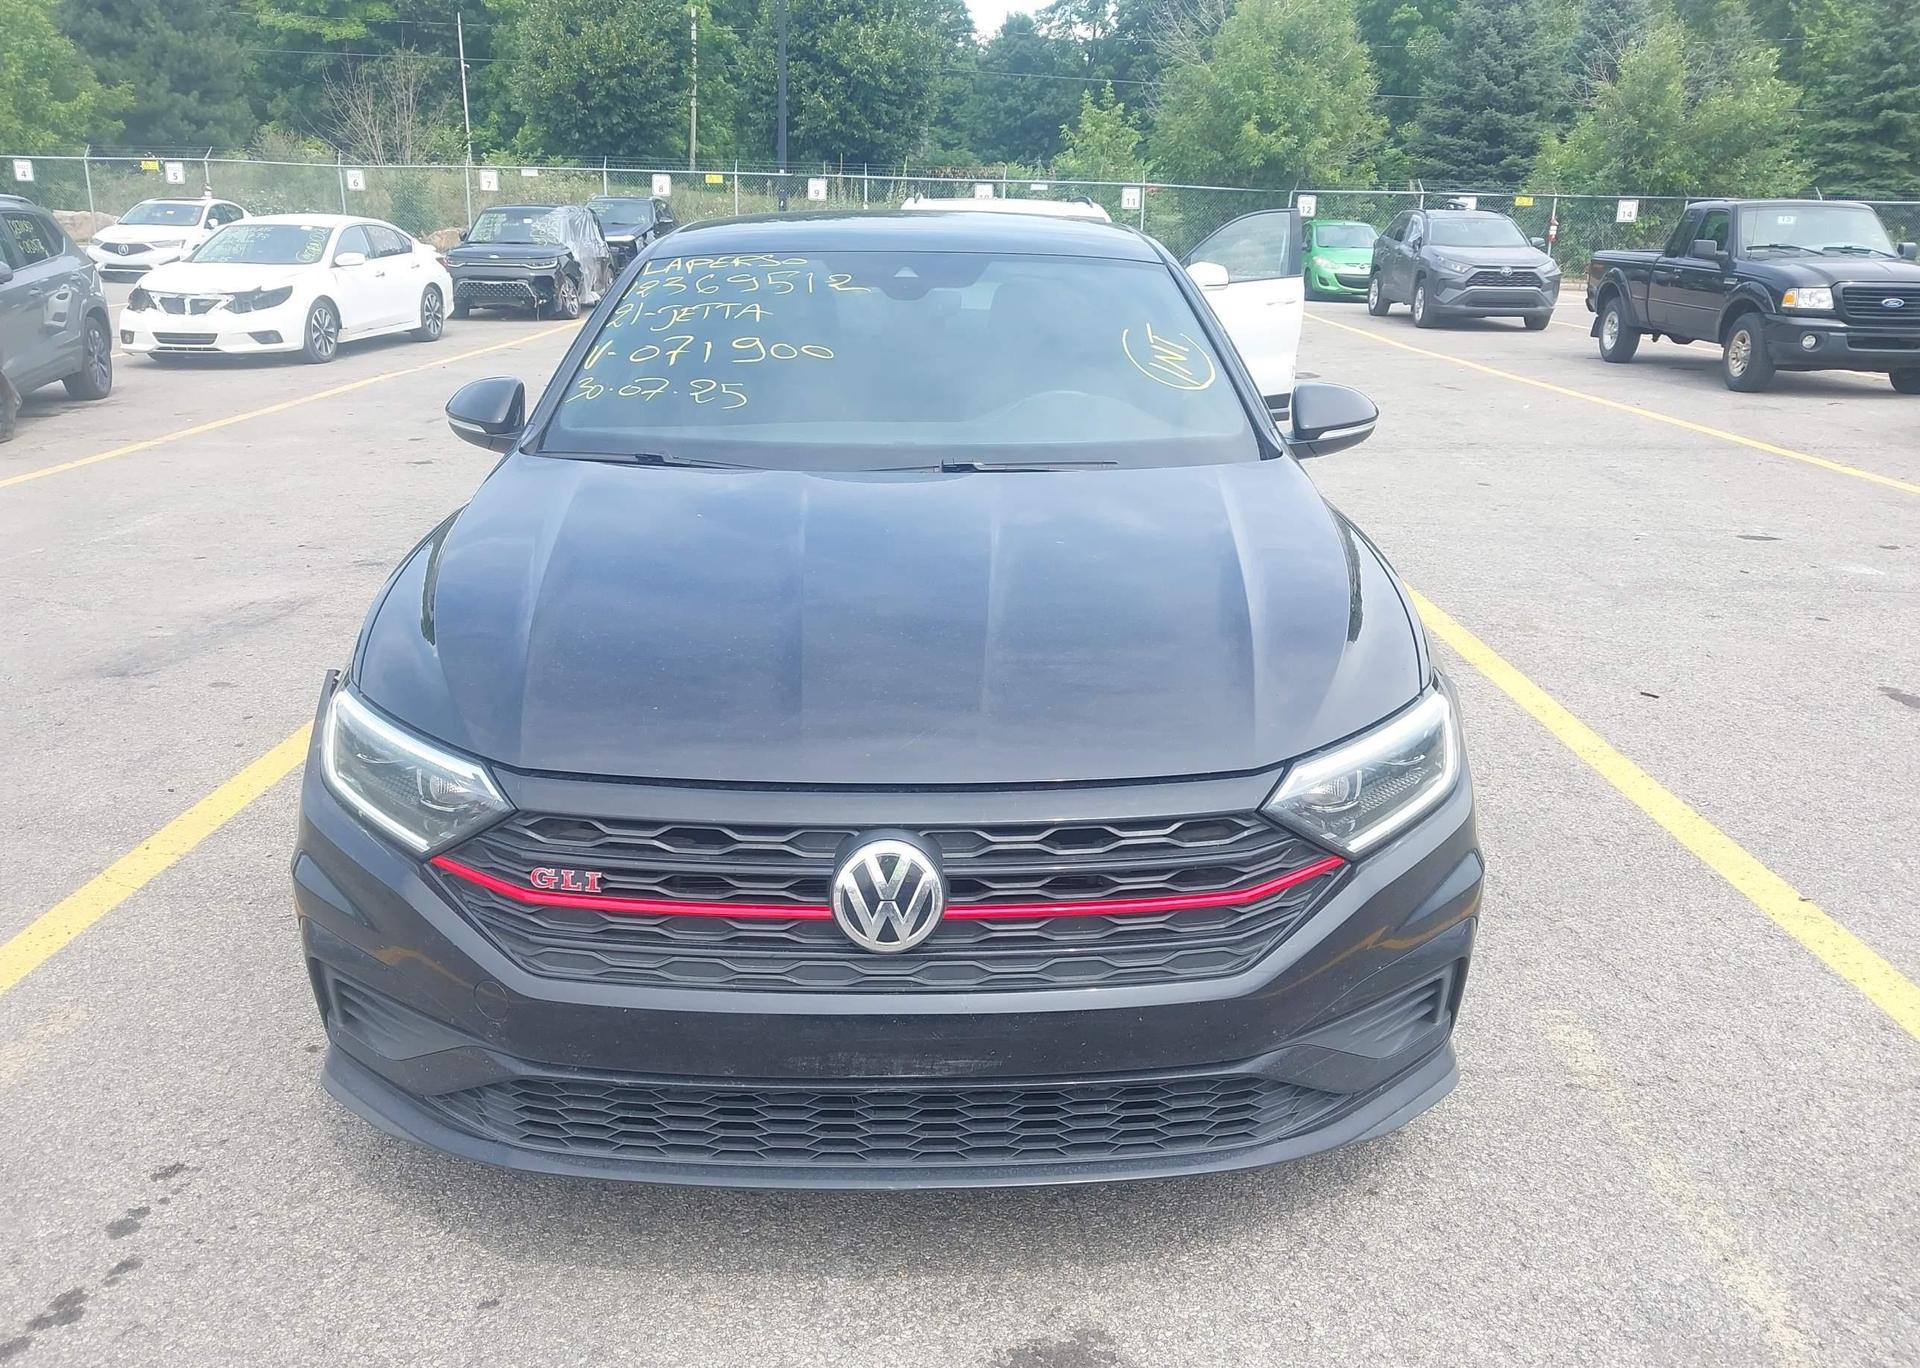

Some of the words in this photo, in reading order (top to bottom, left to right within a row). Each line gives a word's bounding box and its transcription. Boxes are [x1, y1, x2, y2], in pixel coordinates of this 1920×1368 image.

[1302, 206, 1312, 214] 12
[1622, 210, 1632, 218] 14
[530, 866, 603, 893] GLI
